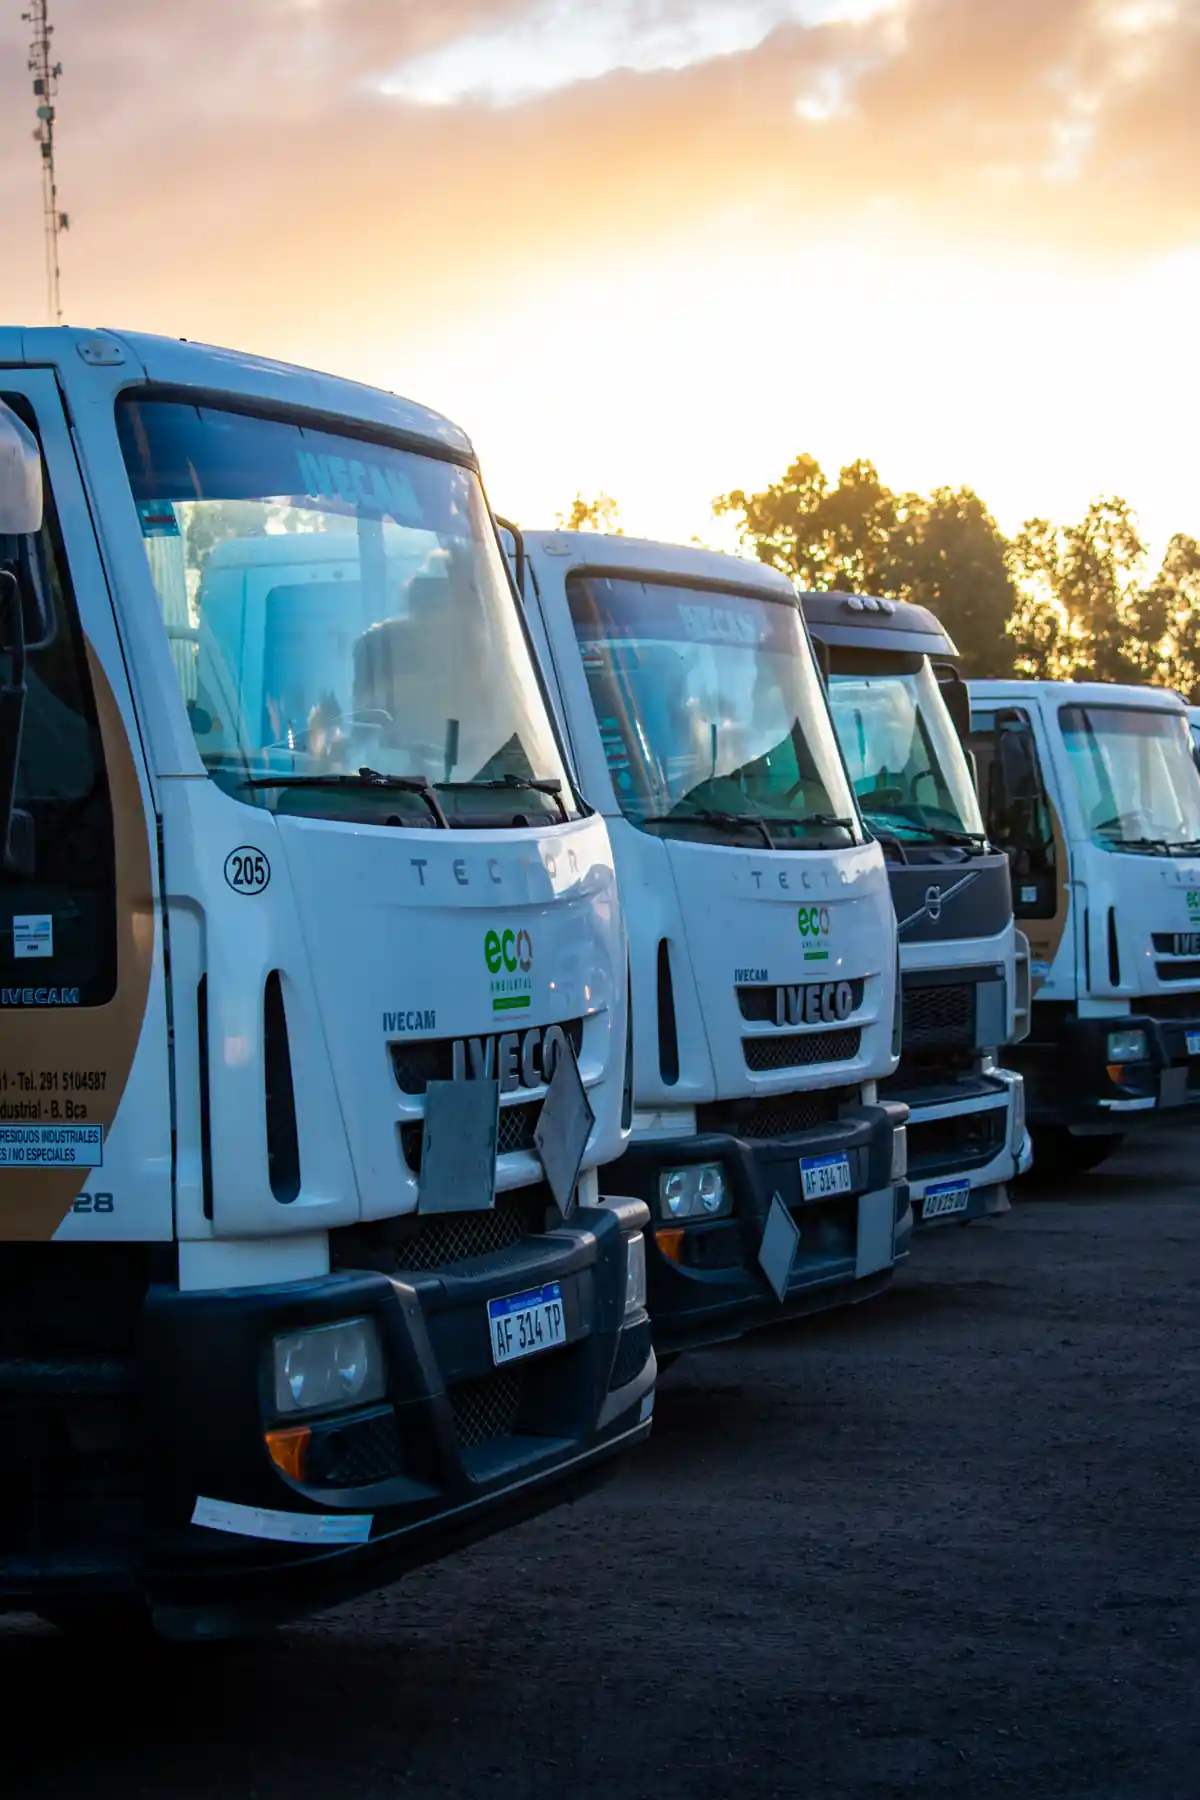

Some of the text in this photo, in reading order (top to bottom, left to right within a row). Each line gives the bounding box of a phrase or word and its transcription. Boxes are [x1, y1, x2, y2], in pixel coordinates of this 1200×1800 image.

[232, 856, 264, 885] 205
[798, 907, 830, 936] eco
[484, 928, 533, 974] eco
[735, 968, 768, 982] IVECAM
[1, 987, 80, 1005] IVECAM
[776, 982, 853, 1027] IVECO
[383, 1010, 436, 1032] IVECAM
[0, 1071, 7, 1090] 1
[18, 1071, 36, 1091] Tel.
[39, 1071, 58, 1090] 291
[62, 1071, 107, 1091] 5104587
[0, 1099, 41, 1119] dustrial
[51, 1099, 63, 1119] B.
[0, 1130, 99, 1144] RESIDUOS INDUSTRIALES
[13, 1148, 24, 1160] NO
[27, 1148, 76, 1162] ESPECIALES
[806, 1170, 817, 1195] AF
[818, 1167, 836, 1192] 314
[69, 1192, 114, 1213] 28
[497, 1303, 562, 1357] AF 314 TP
